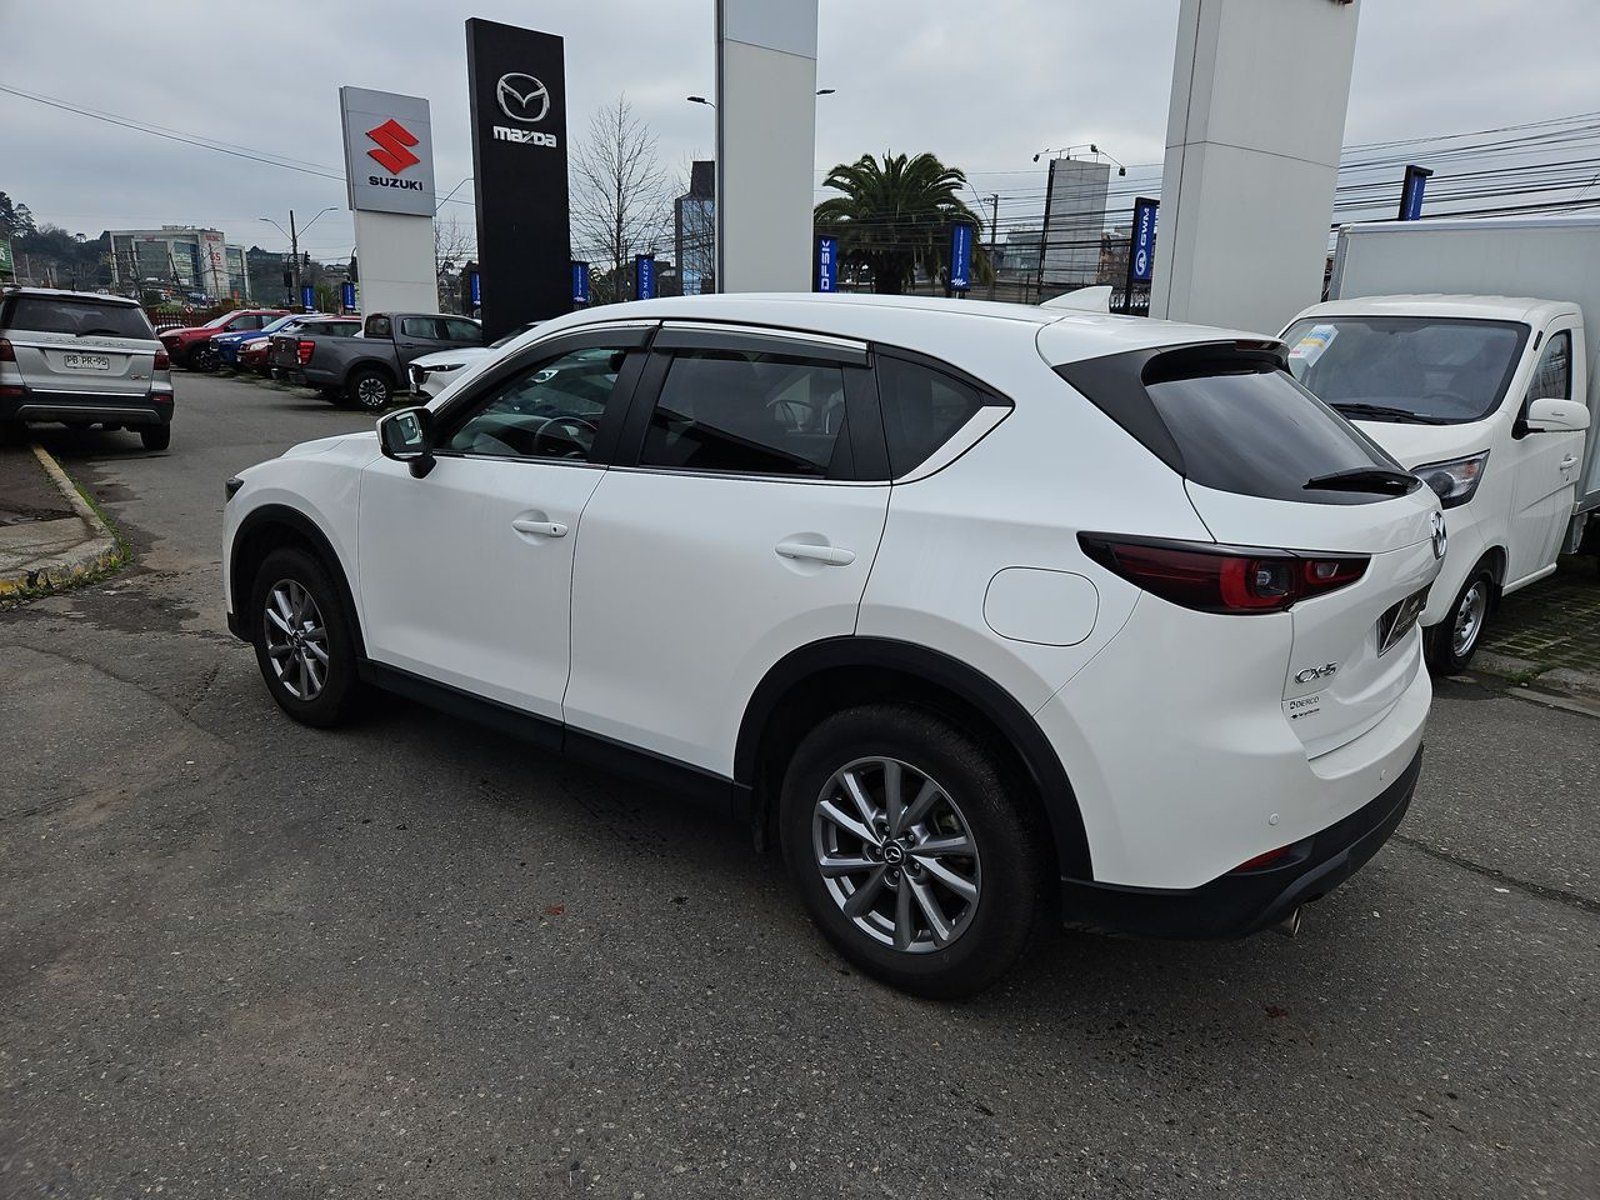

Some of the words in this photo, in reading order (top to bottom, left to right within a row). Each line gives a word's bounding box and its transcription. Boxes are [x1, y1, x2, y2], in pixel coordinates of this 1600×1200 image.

[493, 126, 557, 148] mazda
[368, 175, 423, 191] SUZUKI
[1140, 207, 1150, 246] GWM
[821, 240, 830, 290] DFSK
[1294, 660, 1337, 684] CX-5
